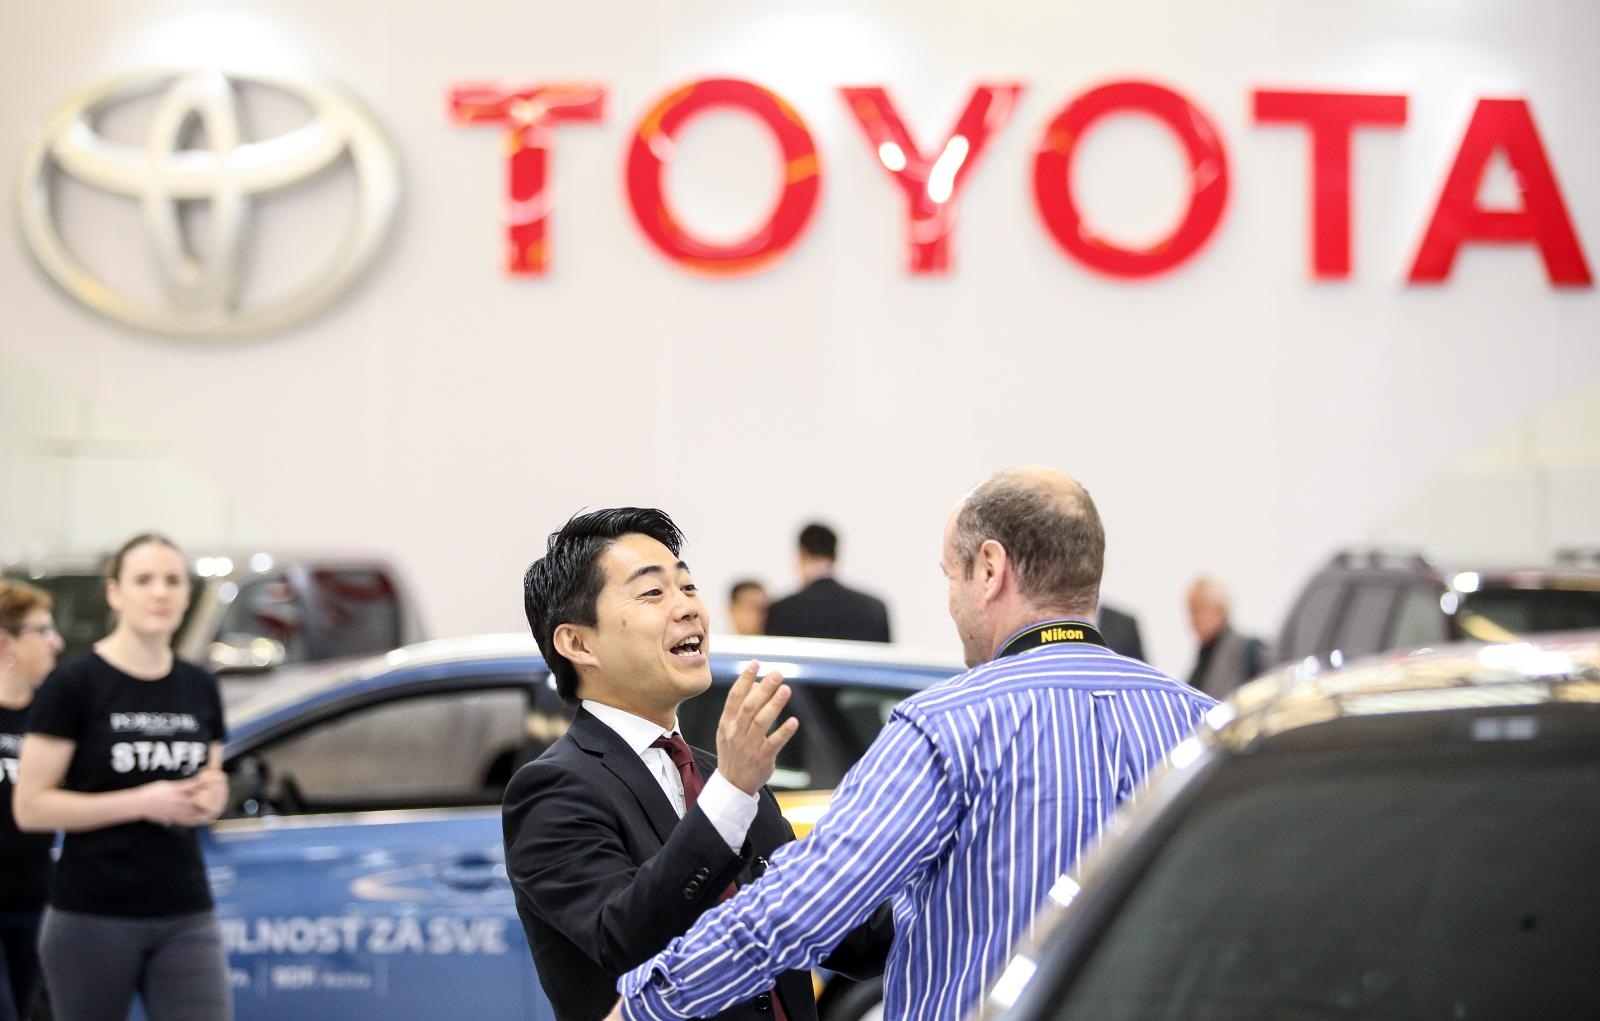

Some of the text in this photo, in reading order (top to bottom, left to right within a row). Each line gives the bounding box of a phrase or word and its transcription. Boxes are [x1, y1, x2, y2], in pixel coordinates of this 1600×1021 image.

[446, 75, 1595, 290] TOYOTA
[1040, 628, 1084, 643] Nikon
[111, 740, 207, 773] STAFF
[427, 916, 509, 954] SVE
